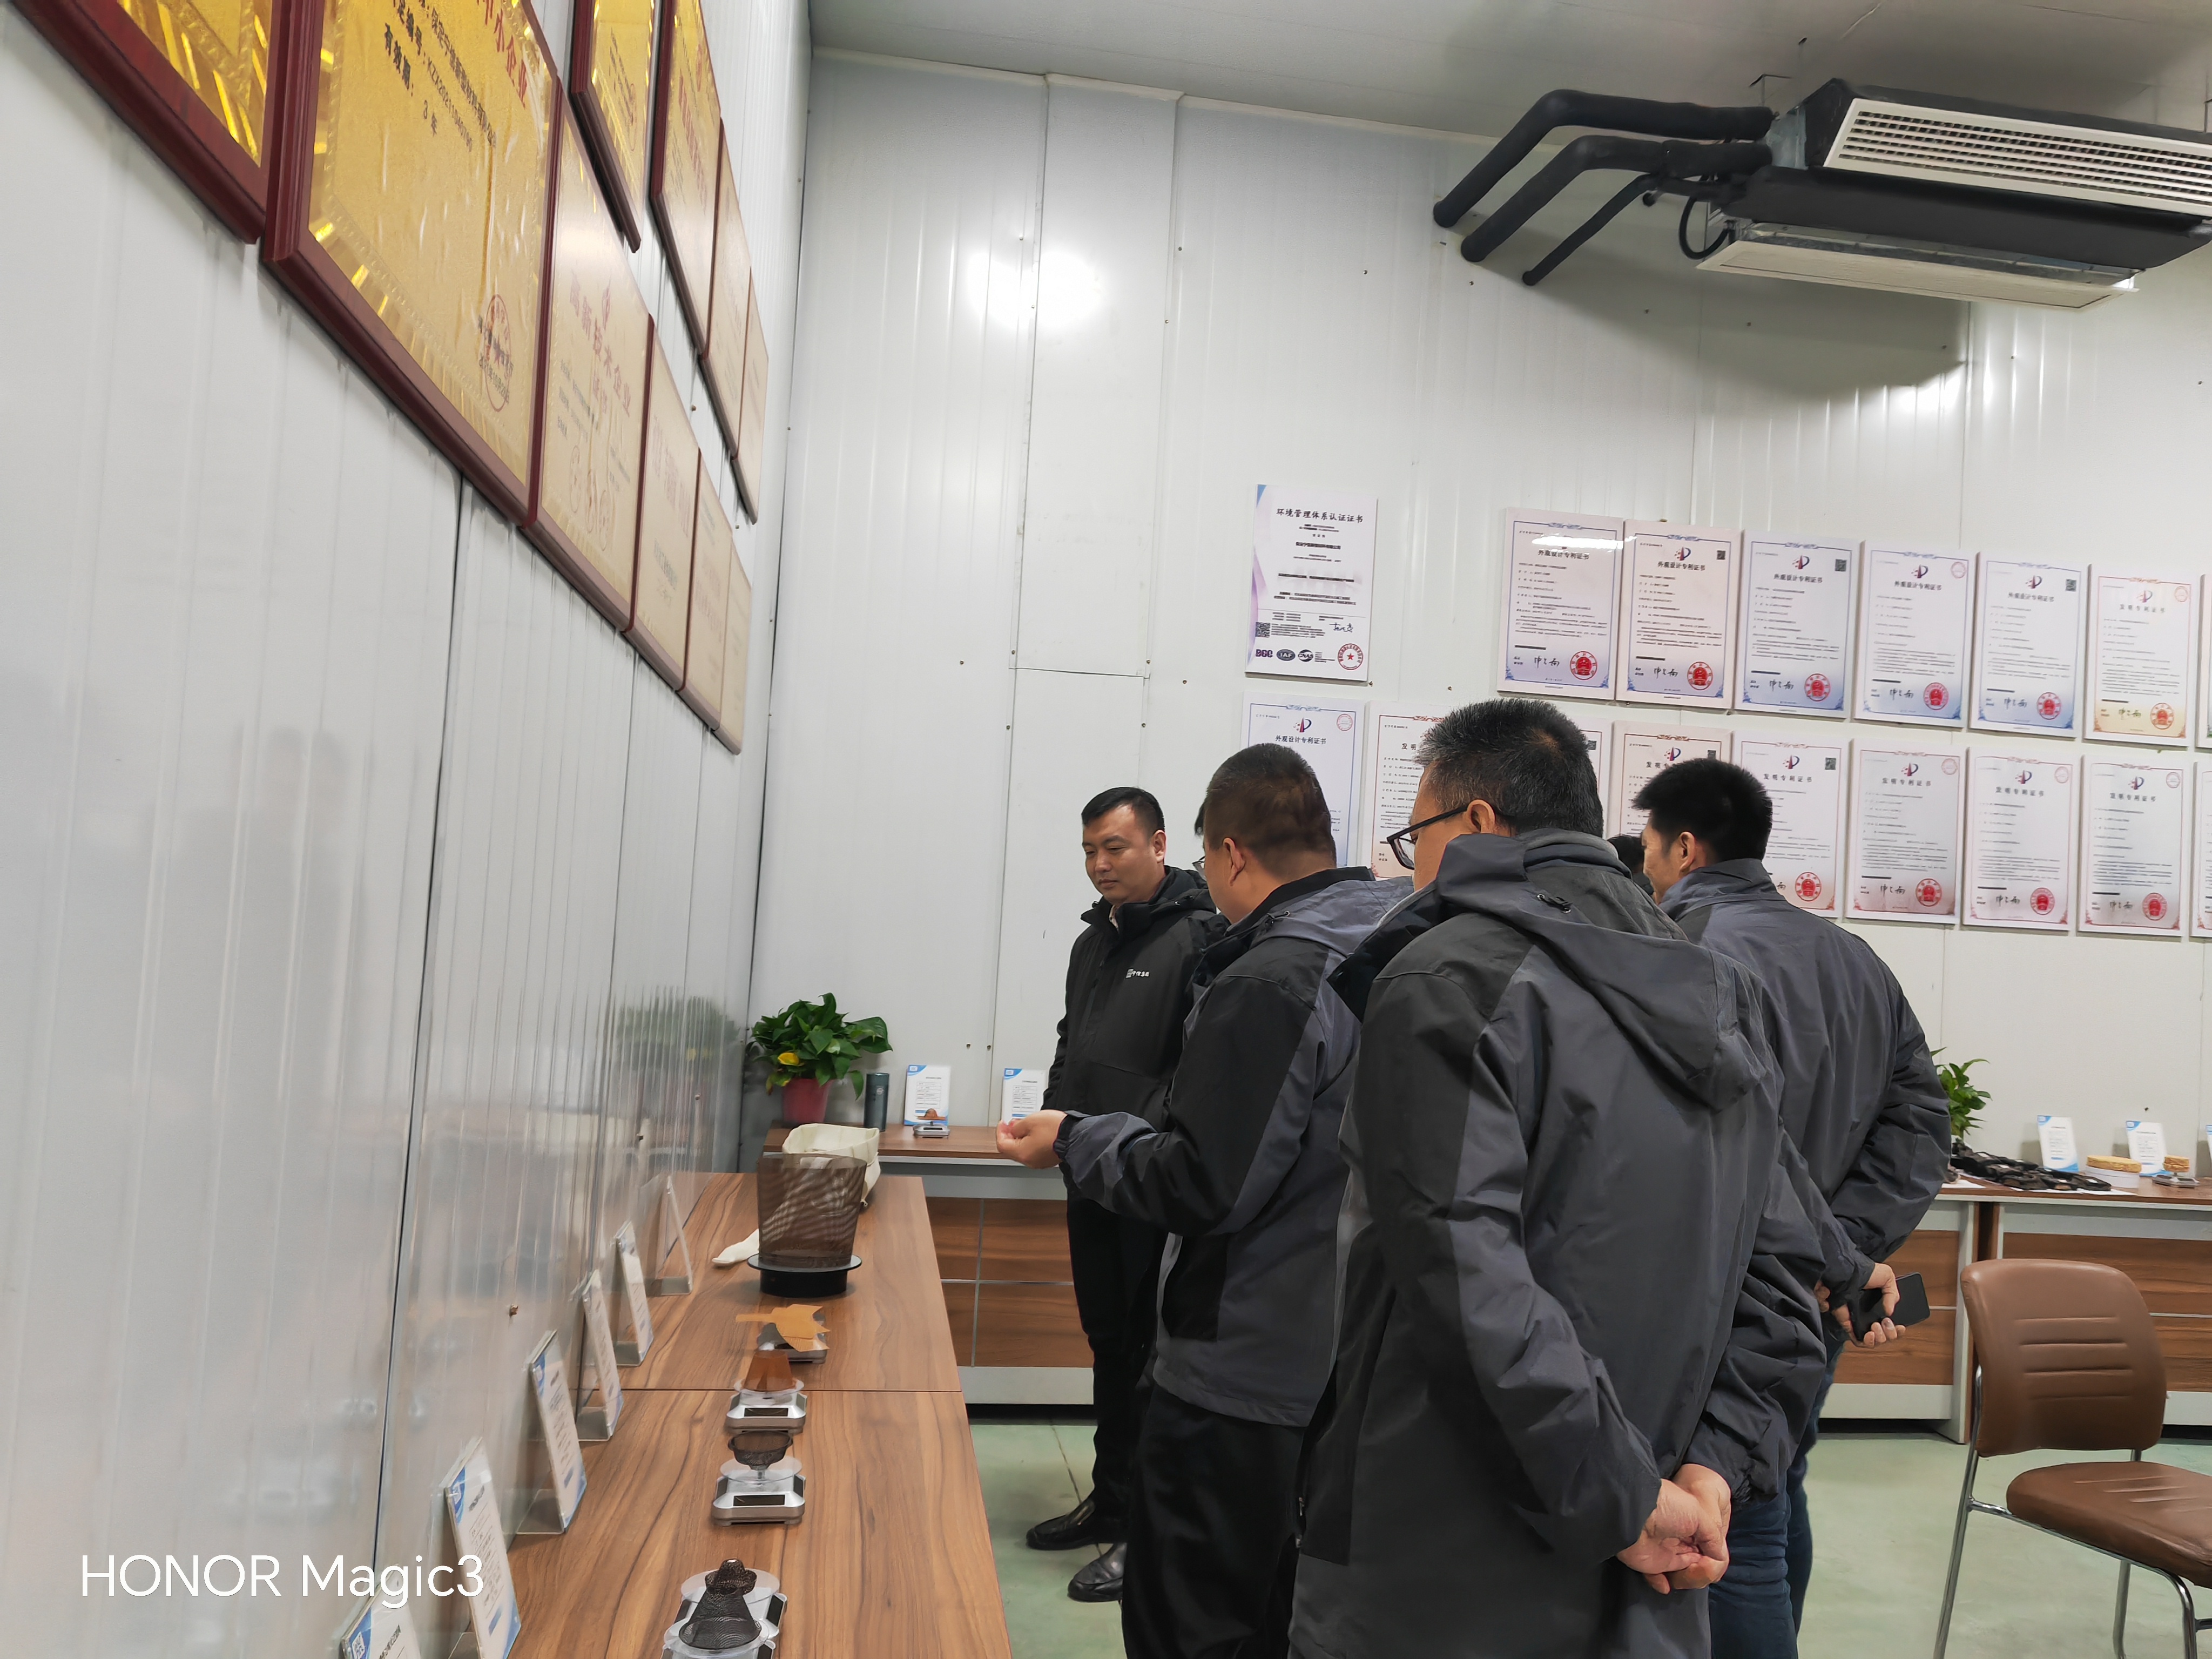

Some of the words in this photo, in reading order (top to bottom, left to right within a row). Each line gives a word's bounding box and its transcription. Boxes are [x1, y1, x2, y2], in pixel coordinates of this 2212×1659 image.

[1276, 508, 1363, 523] 环境管理体系认证证书
[1538, 549, 1590, 560] 外观设计专利证书
[1657, 561, 1705, 571] 外观设计专利证书
[1275, 735, 1327, 745] 外观设计专利证书
[1763, 773, 1812, 783] 发明专利证书
